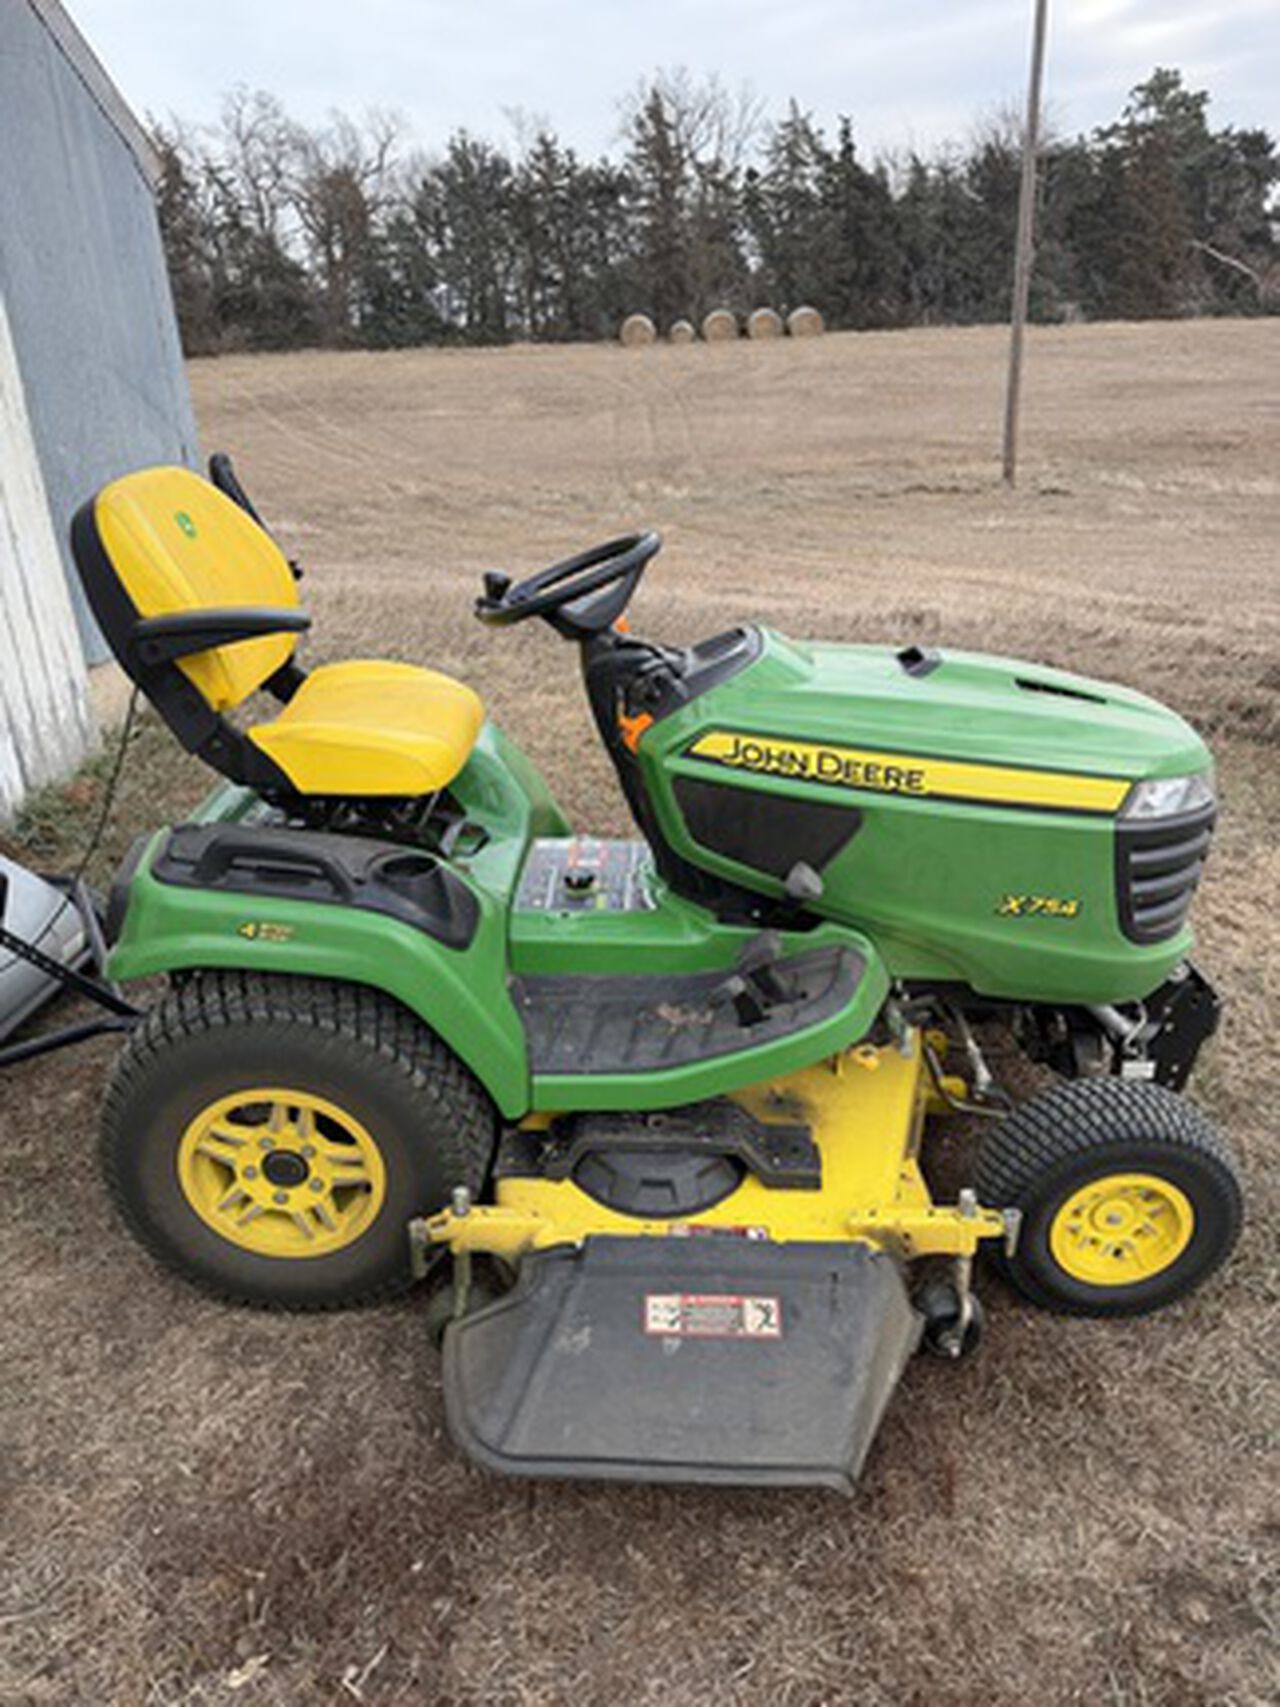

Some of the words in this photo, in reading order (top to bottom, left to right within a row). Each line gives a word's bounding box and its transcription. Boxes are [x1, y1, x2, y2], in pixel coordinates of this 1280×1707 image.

[722, 737, 810, 773] JOHN
[817, 751, 927, 791] DEERE
[998, 895, 1080, 917] X754
